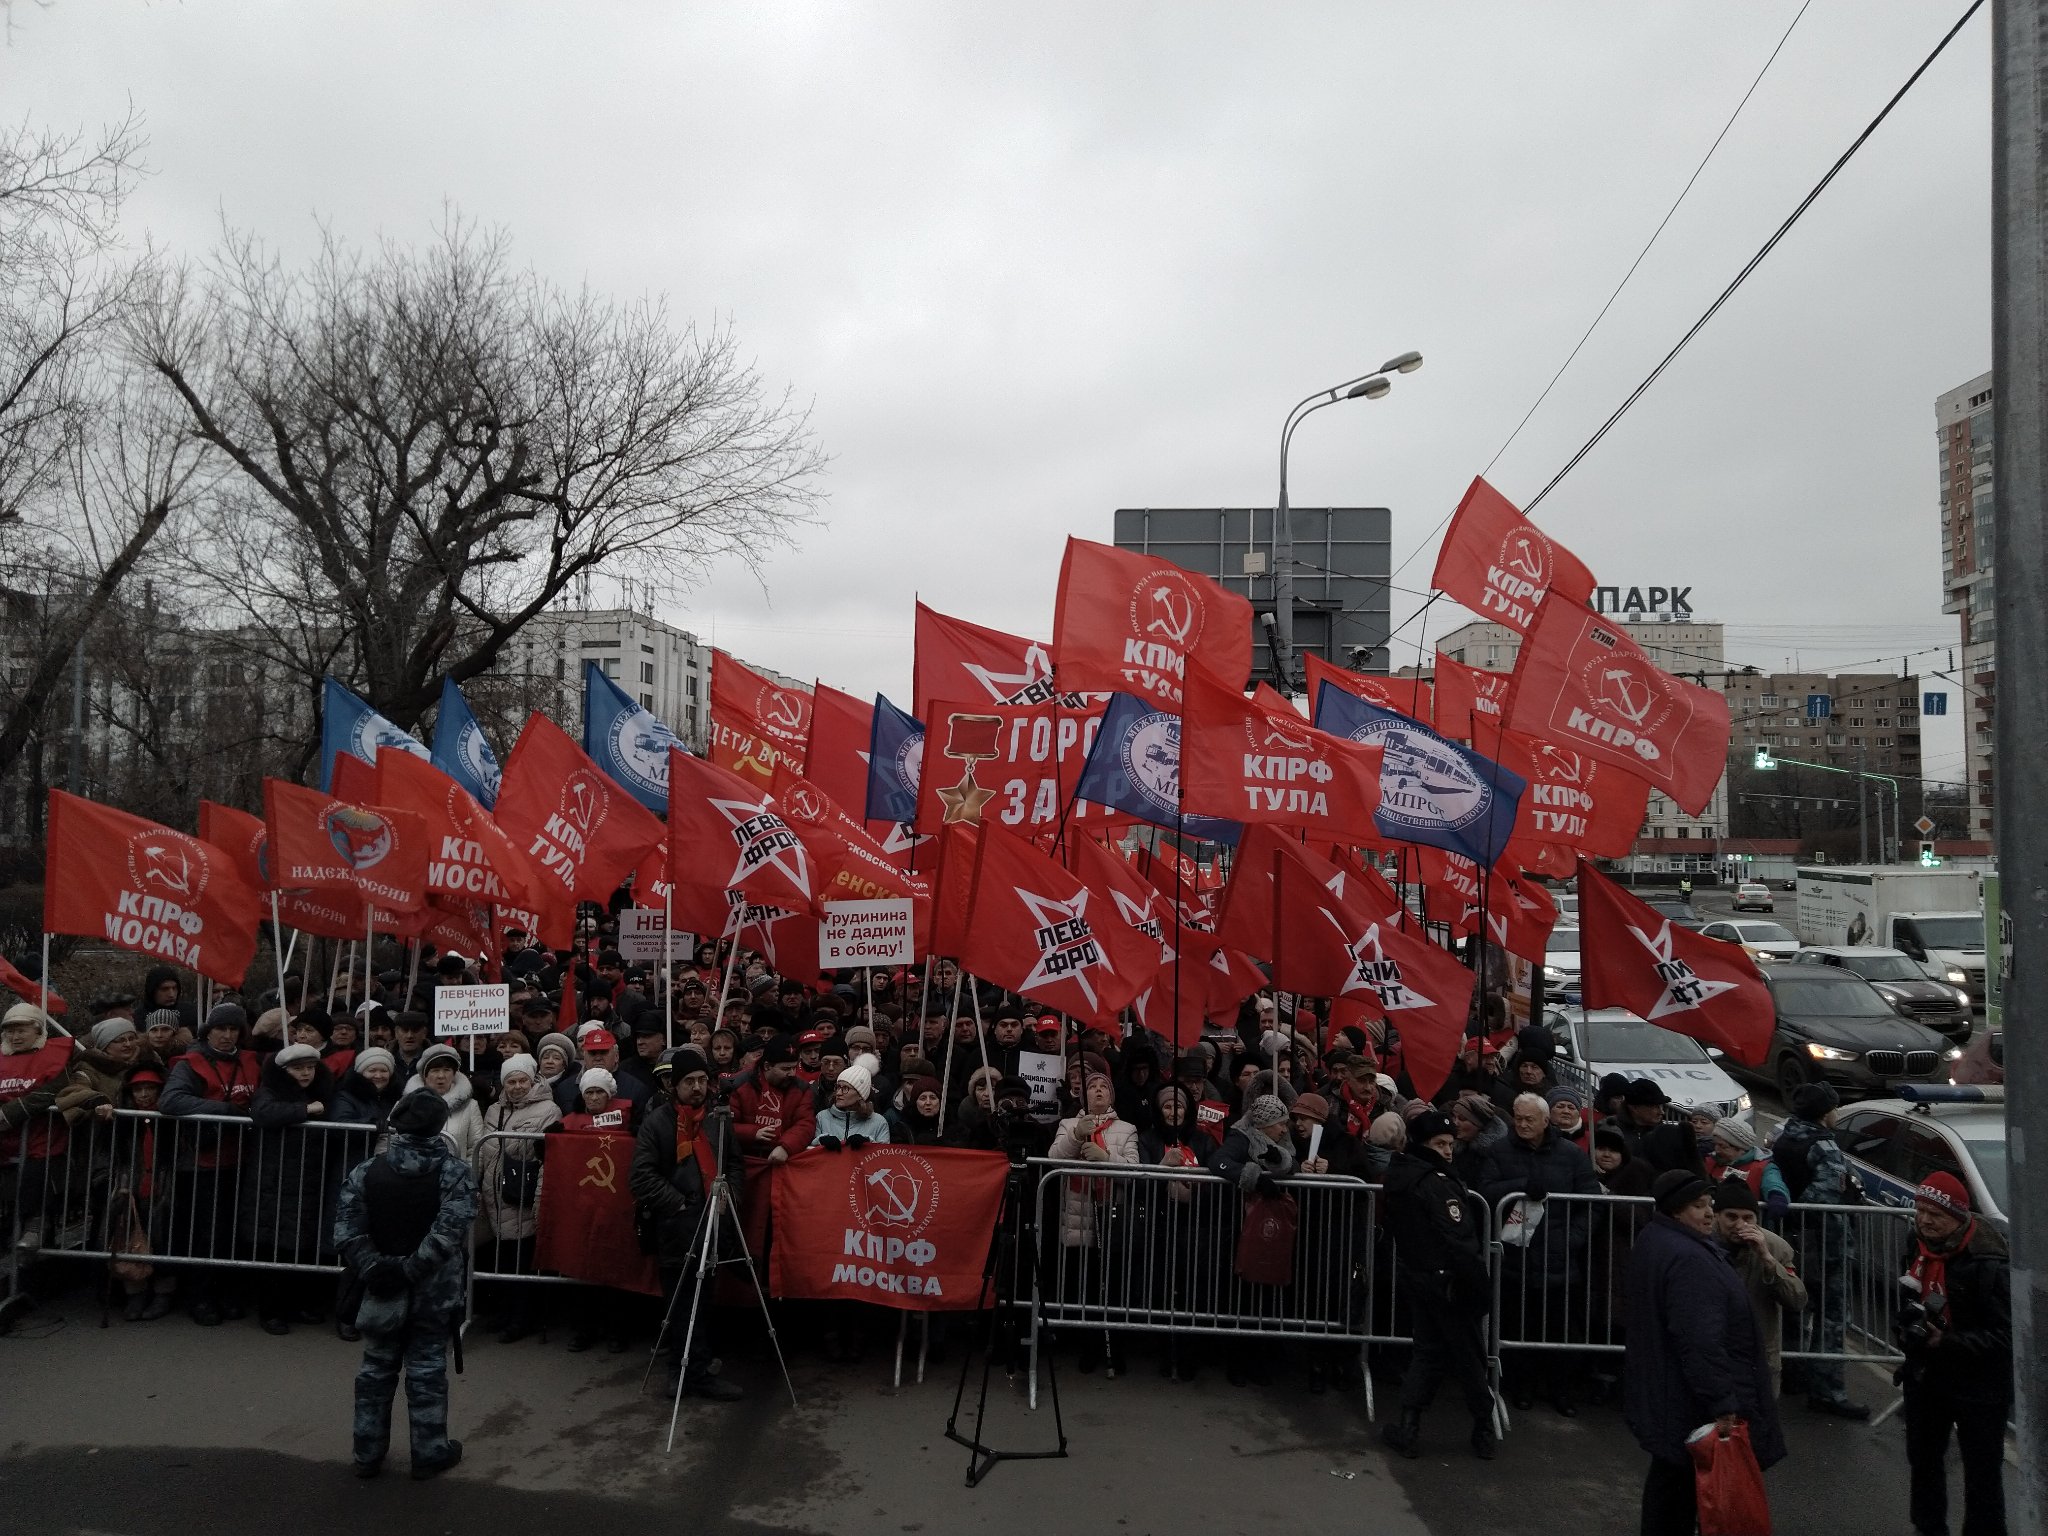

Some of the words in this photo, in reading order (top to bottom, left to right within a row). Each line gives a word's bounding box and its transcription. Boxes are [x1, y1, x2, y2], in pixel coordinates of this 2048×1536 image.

[1586, 586, 1693, 614] ПАРК
[1567, 706, 1660, 760] КПРФ
[1244, 754, 1333, 783] КПРФ
[1001, 778, 1057, 824] ЗА
[1244, 786, 1328, 816] ТУЛА
[1533, 783, 1594, 812] КПРФ
[1532, 809, 1587, 838] ТУЛА
[118, 890, 203, 935] КПРФ
[105, 912, 202, 970] МОСКВА
[827, 929, 846, 940] не
[851, 926, 906, 940] дадим
[830, 947, 840, 957] в
[845, 940, 903, 957] обиду!
[440, 988, 505, 999] ЛЕВЧЕНКО
[438, 1007, 506, 1020] ГРУДИНИН
[442, 1024, 459, 1032] Мы
[471, 1022, 503, 1031] Вами!
[600, 1112, 622, 1123] ТУЛА
[754, 1114, 782, 1126] КПРФ
[864, 1147, 934, 1174] НАРОДОВЛАСТИЕ
[849, 1166, 863, 1185] ТРУД
[849, 1193, 867, 1229] РОССИЯ
[913, 1180, 939, 1238] СОЦИАЛИЗМ
[844, 1228, 937, 1267] КПРФ
[831, 1264, 943, 1297] МОСКВА
